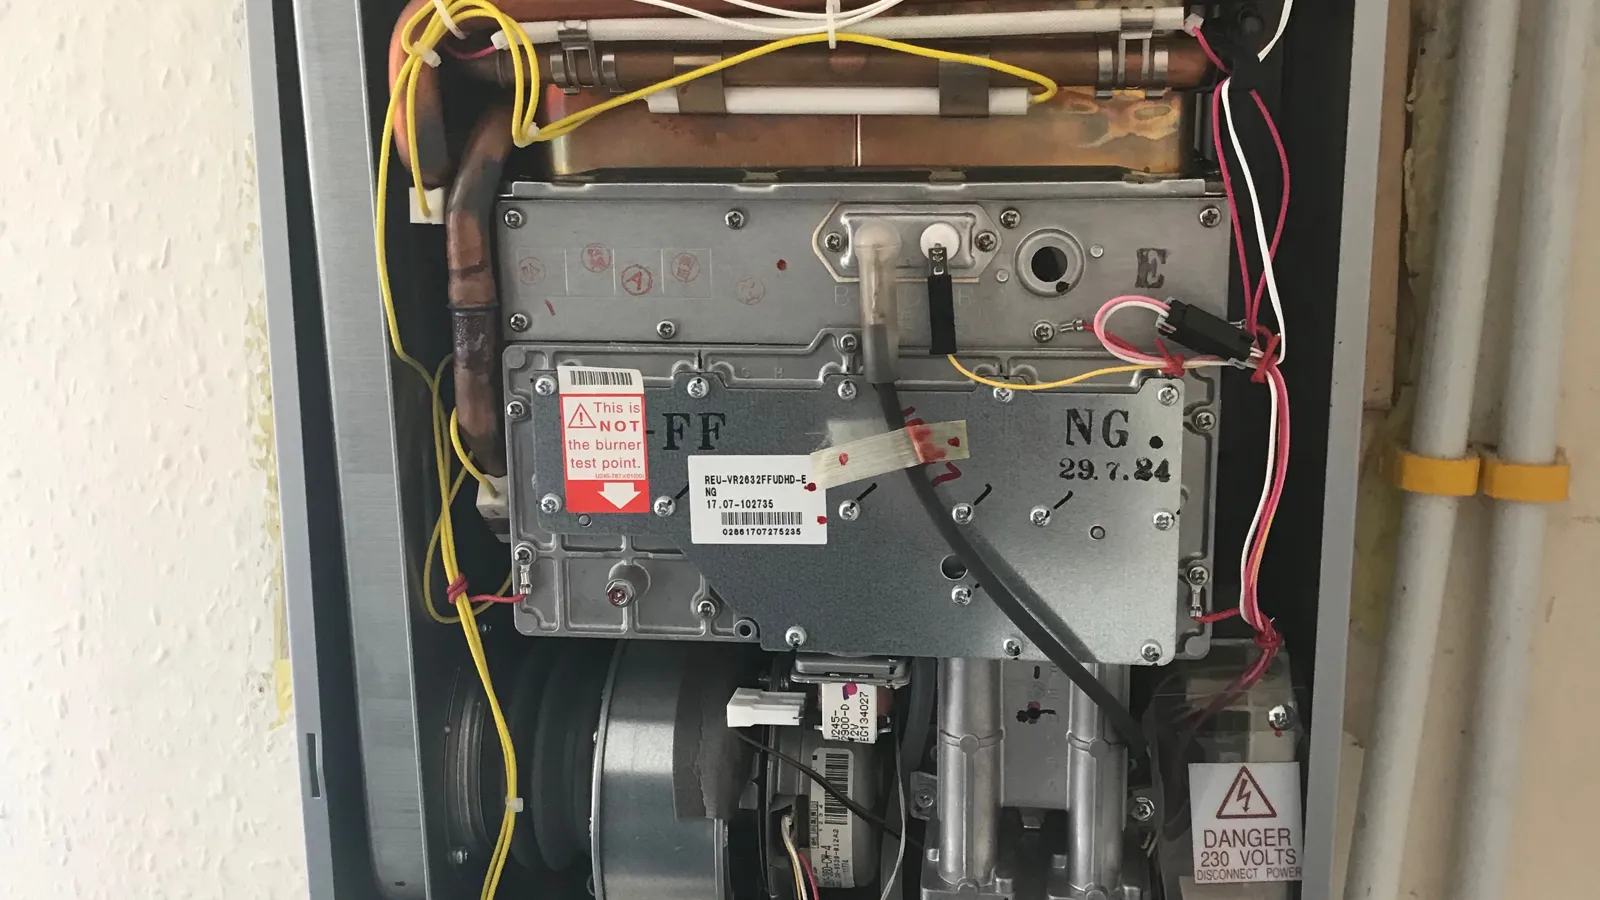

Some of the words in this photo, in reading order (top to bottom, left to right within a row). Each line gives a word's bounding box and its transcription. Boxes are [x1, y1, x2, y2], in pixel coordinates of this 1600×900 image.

[593, 402, 624, 414] This
[629, 402, 641, 414] is
[600, 420, 640, 432] NOT
[1066, 409, 1129, 448] NG
[568, 439, 590, 451] the
[595, 439, 642, 451] burner
[570, 458, 597, 469] test
[602, 458, 641, 471] point.
[704, 475, 807, 485] REU-VR2632FFUDHD-E
[705, 487, 718, 497] NG
[706, 499, 774, 509] 17.07-102735
[1204, 827, 1291, 849] DANGER
[1201, 851, 1229, 868] 230
[1240, 848, 1297, 866] VOLTS
[1197, 868, 1258, 881] DISCONNECT
[1267, 866, 1302, 879] POWER
